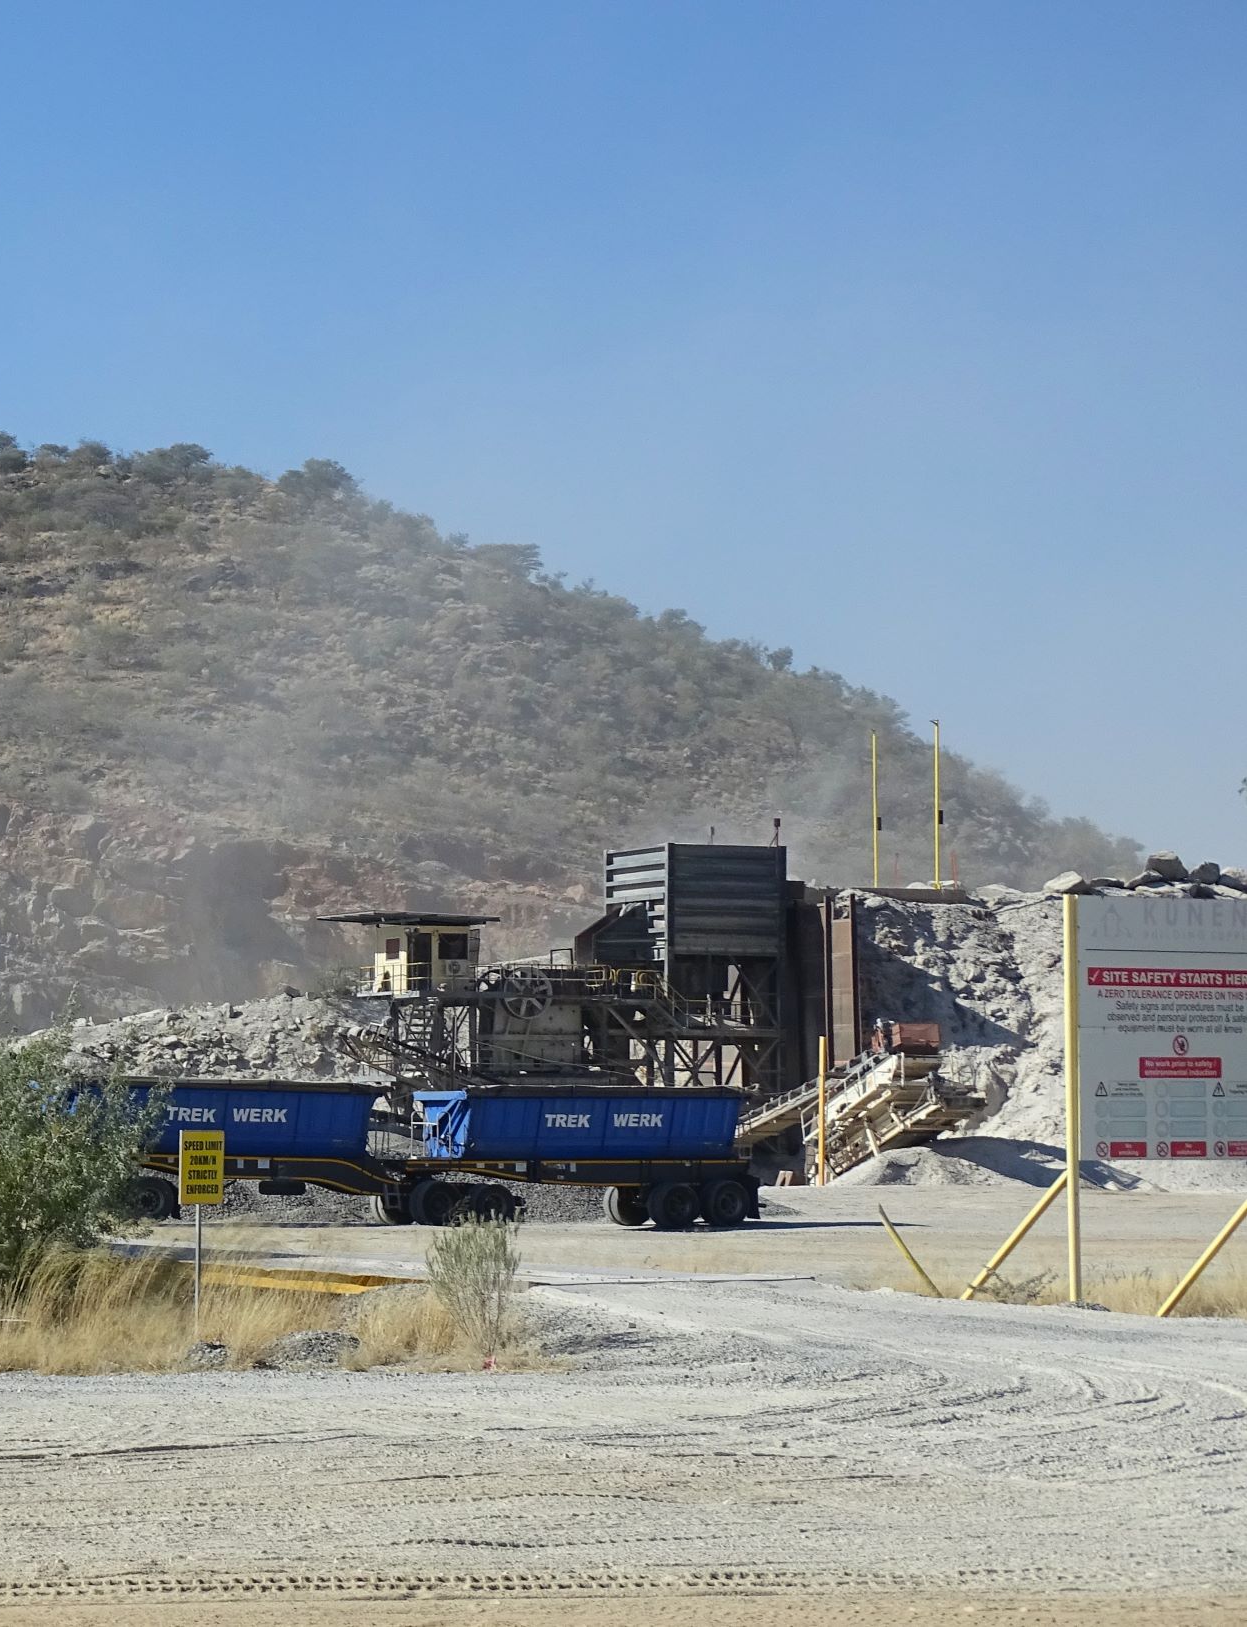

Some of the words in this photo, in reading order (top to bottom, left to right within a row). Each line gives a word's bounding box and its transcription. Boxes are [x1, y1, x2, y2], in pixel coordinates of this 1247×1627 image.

[1103, 971, 1128, 983] SITE
[1132, 972, 1176, 983] SAFETY
[1180, 973, 1223, 984] STARTS
[1098, 989, 1103, 998] A
[1104, 989, 1125, 998] ZERO
[1127, 990, 1172, 999] TOLERANCE
[1174, 990, 1212, 1000] OPERATES
[1215, 991, 1226, 1000] ON
[1227, 991, 1244, 1000] THIS
[1116, 1001, 1139, 1012] Safety
[1140, 1002, 1159, 1013] signs
[1161, 1002, 1175, 1011] and
[1176, 1002, 1215, 1012] procedures
[1217, 1003, 1234, 1011] must
[1235, 1003, 1244, 1012] be
[1107, 1012, 1140, 1022] observed
[1142, 1012, 1155, 1021] and
[1157, 1013, 1187, 1023] personal
[1189, 1013, 1223, 1023] protection
[1225, 1014, 1230, 1022] &
[1118, 1024, 1156, 1034] equipment
[1157, 1025, 1175, 1033] must
[1176, 1025, 1185, 1033] be
[1195, 1060, 1212, 1068] safety
[167, 1107, 217, 1122] TREK
[233, 1108, 288, 1123] WERK
[545, 1114, 591, 1128] TREK
[613, 1113, 663, 1128] WERK
[184, 1140, 204, 1151] SPEED
[205, 1140, 223, 1151] LIMIT
[190, 1155, 216, 1166] 20KM/H
[188, 1170, 217, 1180] STRICTLY
[186, 1184, 219, 1194] ENFORCED
